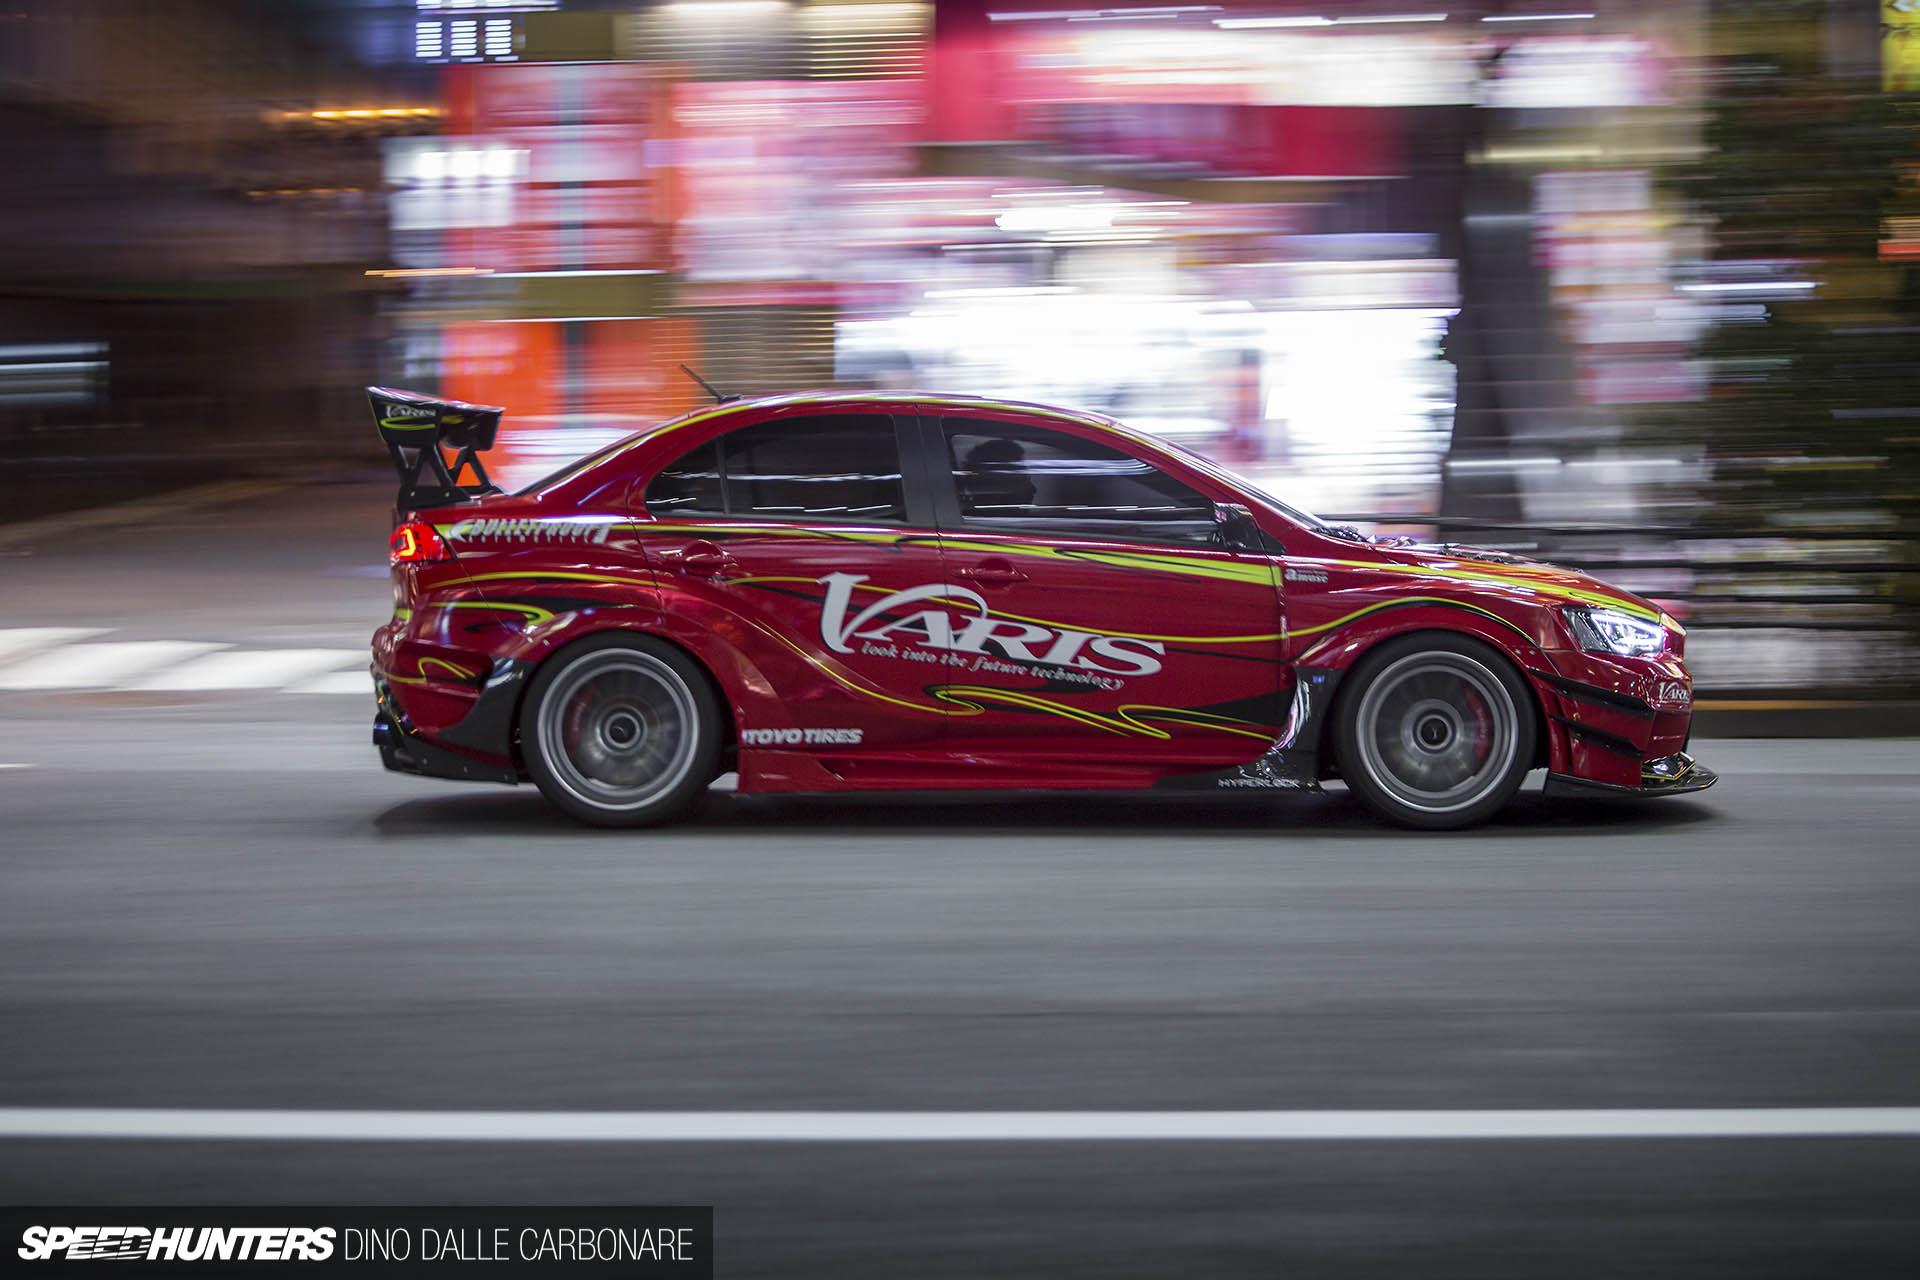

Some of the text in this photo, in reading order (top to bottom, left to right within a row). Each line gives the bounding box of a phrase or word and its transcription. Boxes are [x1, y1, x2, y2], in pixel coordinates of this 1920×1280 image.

[816, 571, 1165, 676] VARIS
[861, 641, 1124, 691] look into the future technology
[747, 728, 864, 744] TOYO TIRES
